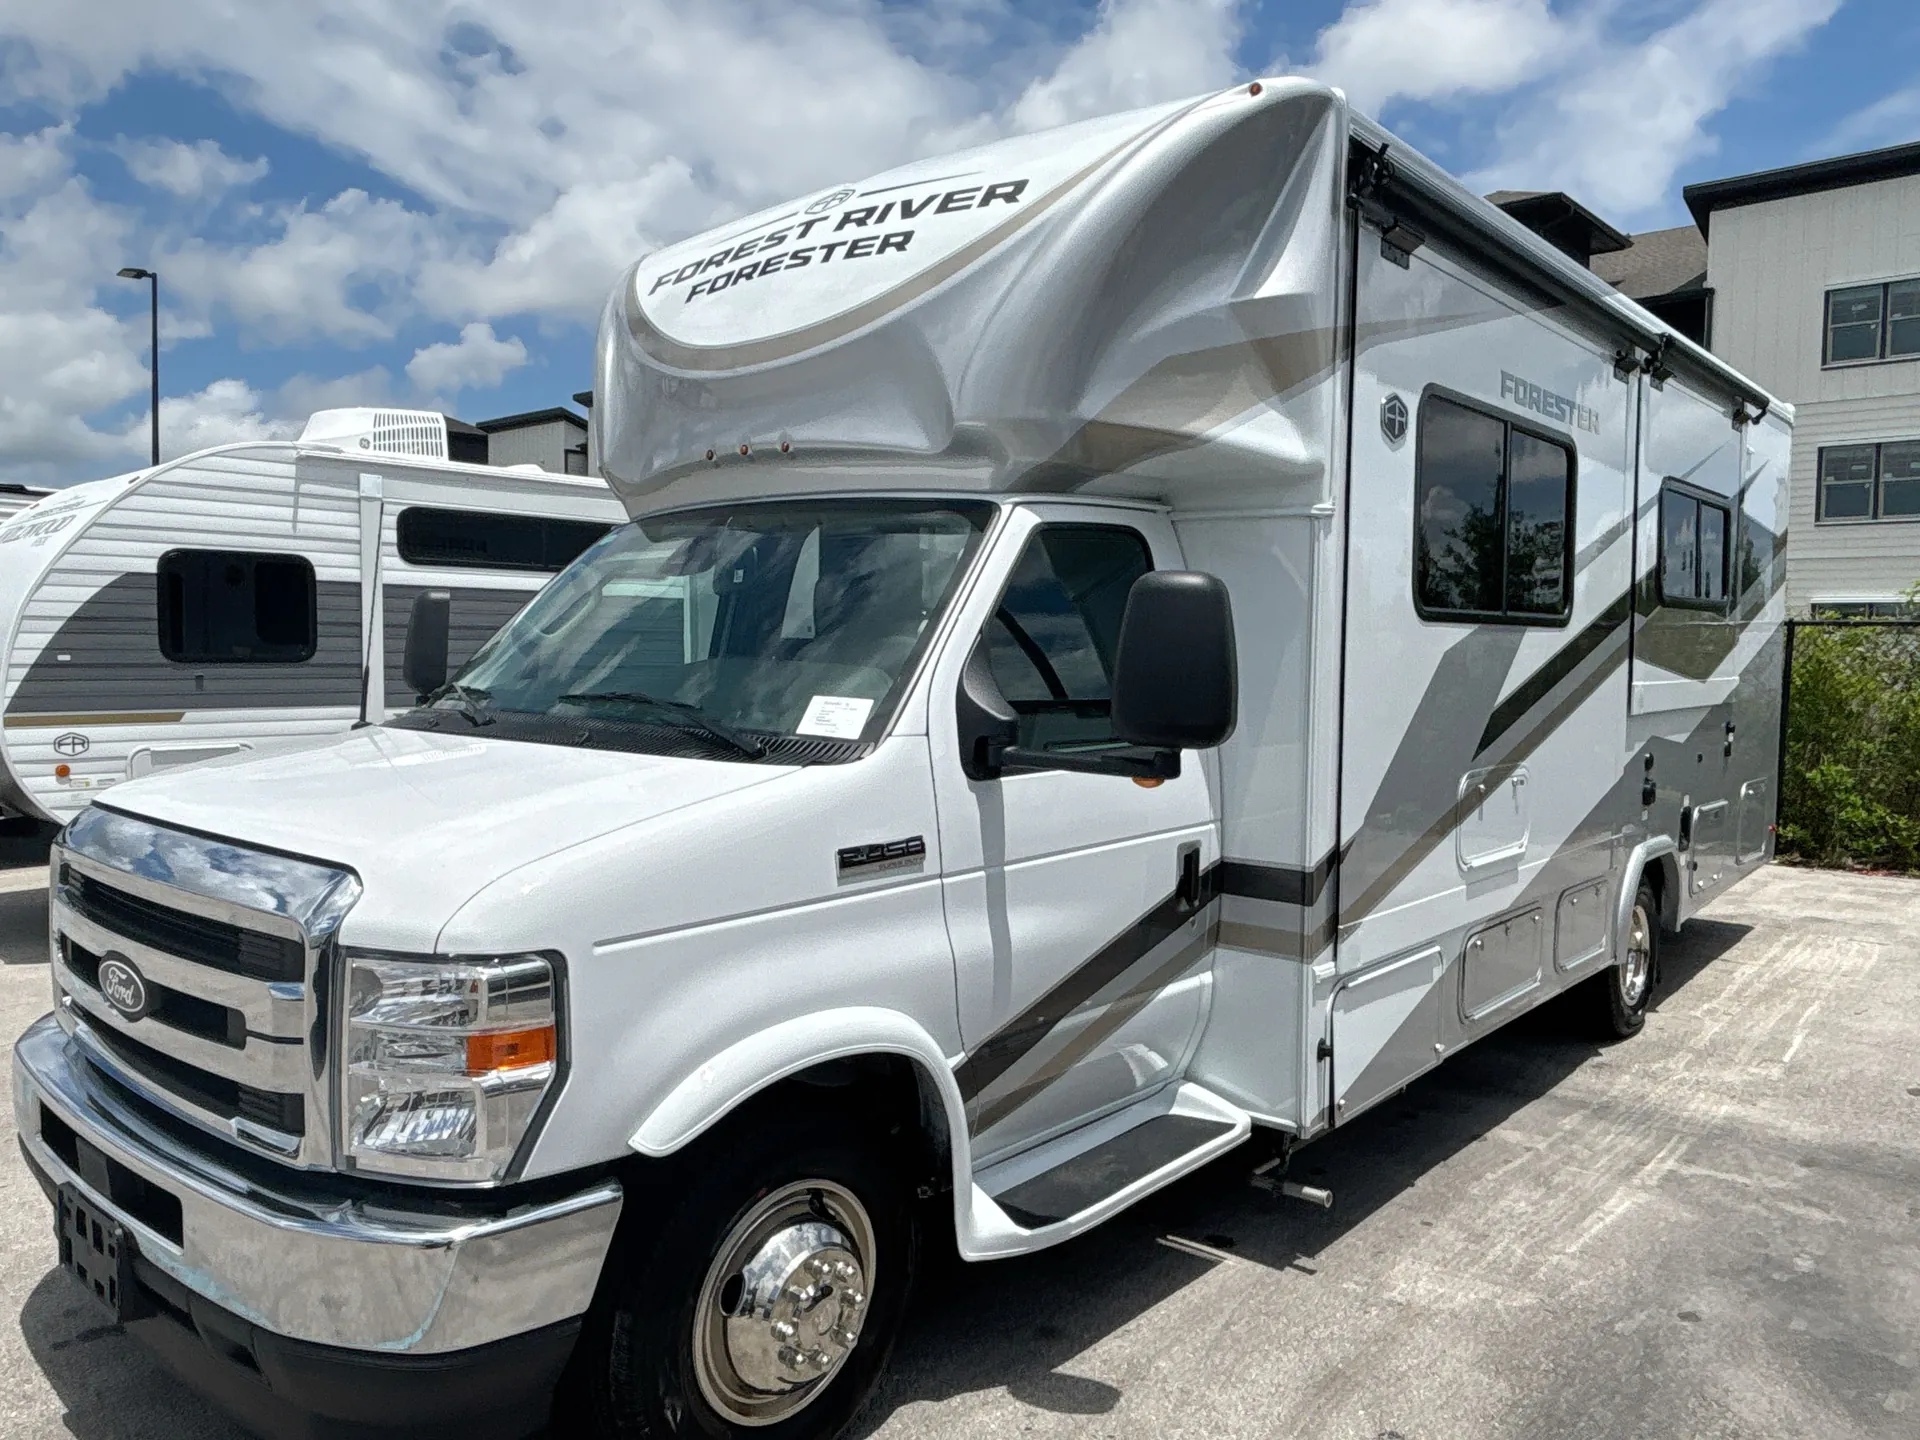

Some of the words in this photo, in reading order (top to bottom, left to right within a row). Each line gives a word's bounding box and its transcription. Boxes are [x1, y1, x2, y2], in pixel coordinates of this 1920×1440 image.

[648, 214, 830, 296] FOREST
[833, 178, 1030, 232] RIVER
[684, 229, 916, 304] FORESTER
[1500, 369, 1601, 435] FORESTER
[106, 966, 135, 1006] Ford
